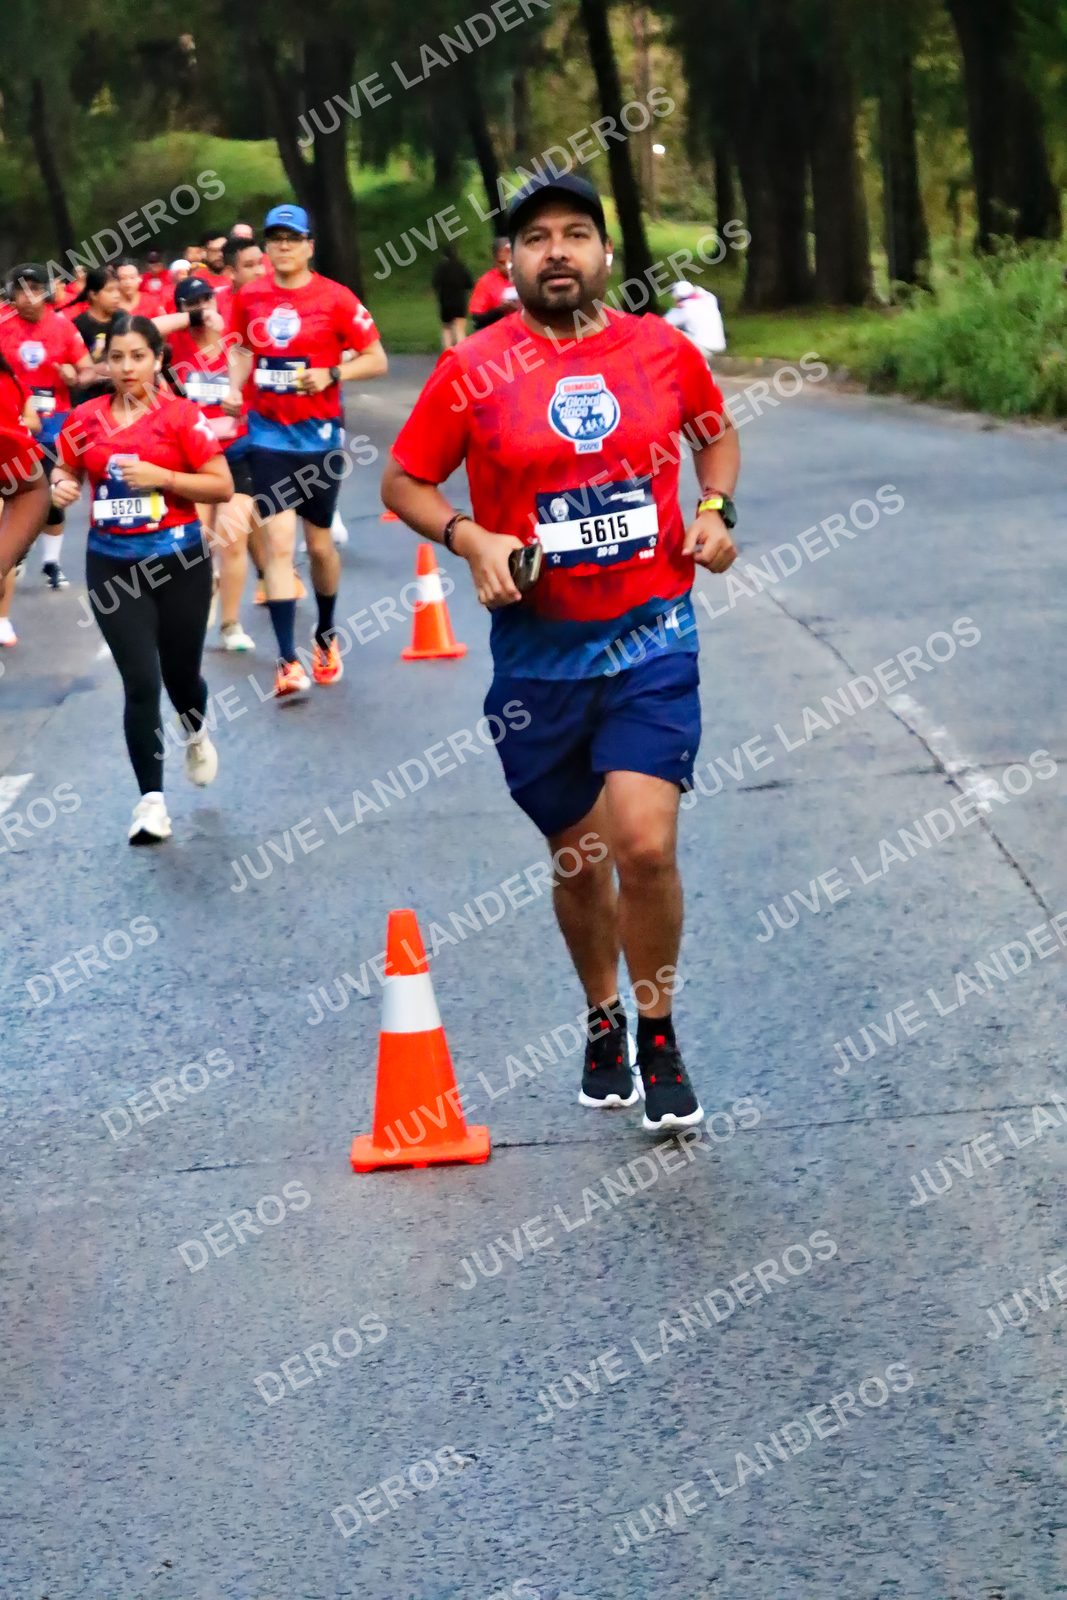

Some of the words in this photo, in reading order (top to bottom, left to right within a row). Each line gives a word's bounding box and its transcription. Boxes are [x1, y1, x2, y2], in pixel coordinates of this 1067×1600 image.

[566, 394, 601, 408] Global
[560, 406, 589, 418] Race
[111, 499, 142, 515] 5520
[580, 515, 629, 545] 5615
